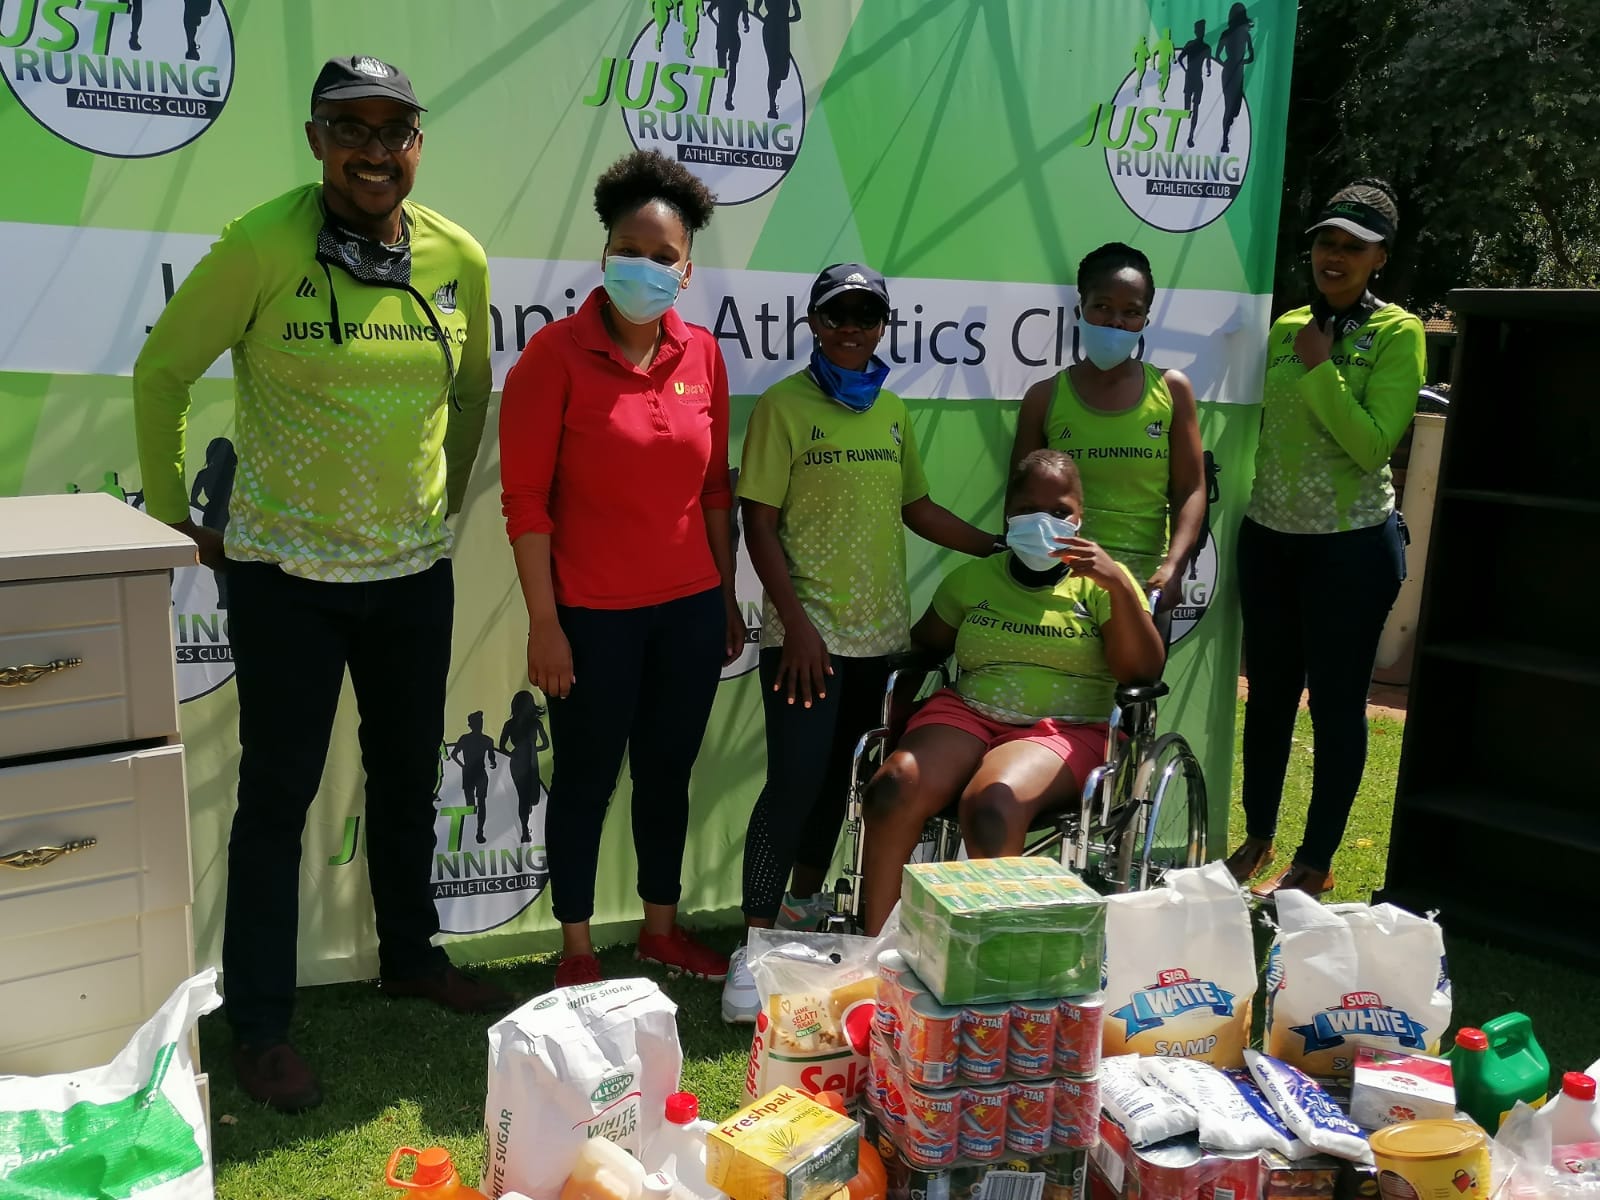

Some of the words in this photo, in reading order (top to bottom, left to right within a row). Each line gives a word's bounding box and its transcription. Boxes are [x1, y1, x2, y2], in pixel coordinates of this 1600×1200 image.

[0, 0, 131, 56] UST
[14, 48, 221, 98] RUNNING
[582, 57, 729, 116] JUST
[76, 91, 162, 112] ATHLETICS
[166, 100, 208, 116] CLUB
[638, 111, 794, 152] RUNNING
[1072, 103, 1193, 153] JUST
[684, 149, 749, 166] ATHLETICS
[752, 153, 784, 168] CLUB
[1116, 150, 1240, 182] RUNNING
[1151, 182, 1203, 196] ATHLETICS
[1205, 185, 1231, 197] CLUB
[344, 322, 440, 342] RUNNING
[713, 294, 986, 368] Athtics
[803, 450, 843, 466] JUST
[847, 448, 898, 464] RUNNING
[1088, 447, 1152, 459] RUNNING
[1171, 608, 1197, 619] CLUB
[966, 614, 1000, 629] JUST
[1001, 621, 1075, 638] RUNNING
[435, 845, 548, 881] NNING
[435, 880, 502, 897] ATHLETICS
[505, 875, 538, 890] CLUB
[599, 984, 633, 998] SUGAR
[1144, 983, 1218, 1015] WHITE
[1346, 992, 1379, 1008] SUPER
[792, 1010, 818, 1026] SELATI
[982, 1017, 1003, 1029] STAR
[1030, 1012, 1052, 1025] STAR
[1327, 1009, 1408, 1034] WHITE
[1154, 1034, 1217, 1058] SAMP
[800, 1062, 870, 1101] Sela
[931, 1101, 952, 1113] STAR
[982, 1095, 1002, 1107] STAR
[1023, 1089, 1045, 1104] STAR
[587, 1103, 637, 1139] WHITE
[720, 1090, 798, 1138] Freshpak
[495, 1108, 513, 1164] SUGAR
[603, 1119, 637, 1142] GAR
[806, 1143, 843, 1175] Freshpak
[492, 1164, 505, 1200] HITE
